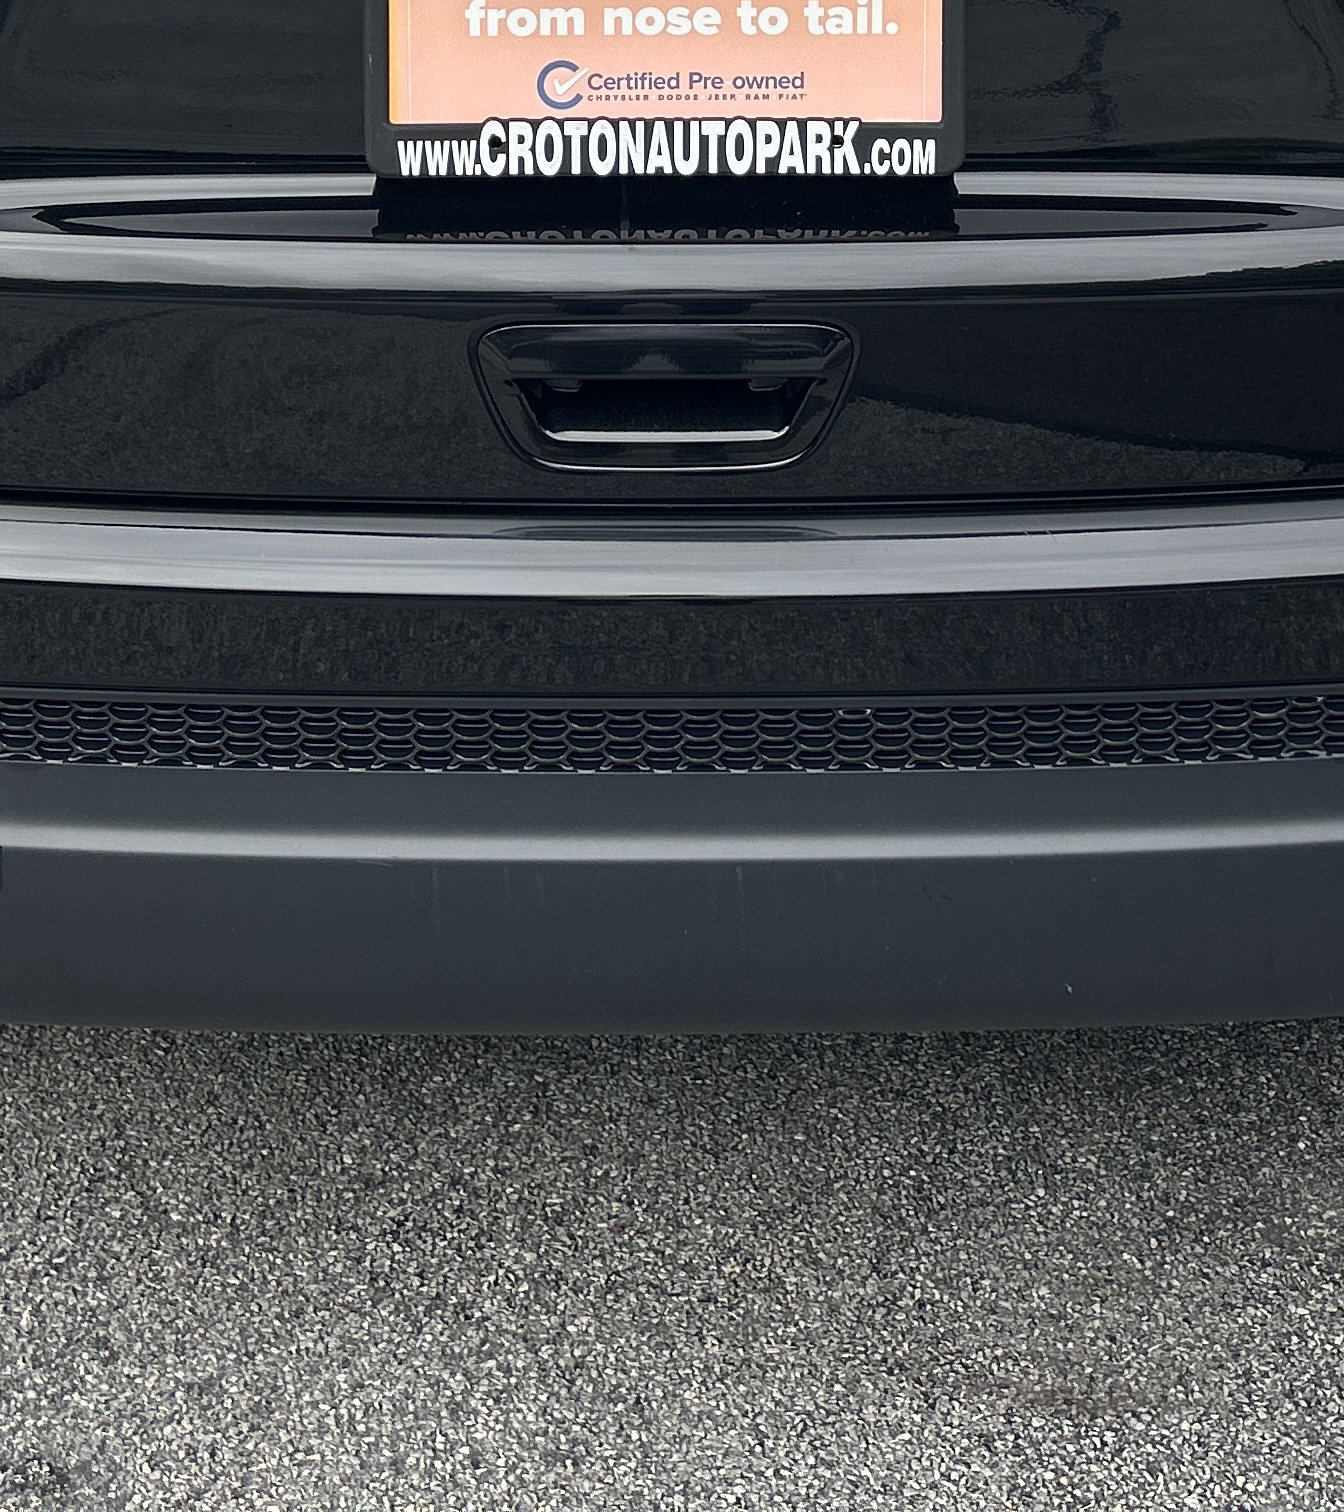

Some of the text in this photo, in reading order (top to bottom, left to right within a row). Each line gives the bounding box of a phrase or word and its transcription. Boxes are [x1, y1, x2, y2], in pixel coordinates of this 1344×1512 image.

[603, 5, 721, 37] nose
[737, 2, 791, 37] to
[587, 71, 680, 91] Certified
[587, 94, 650, 102] CHRYSLER
[657, 93, 699, 101] DODGE
[745, 93, 770, 101] RAM
[778, 93, 806, 101] FIAT
[397, 119, 937, 177] WWW.CROTONAUTOPARK.COM
